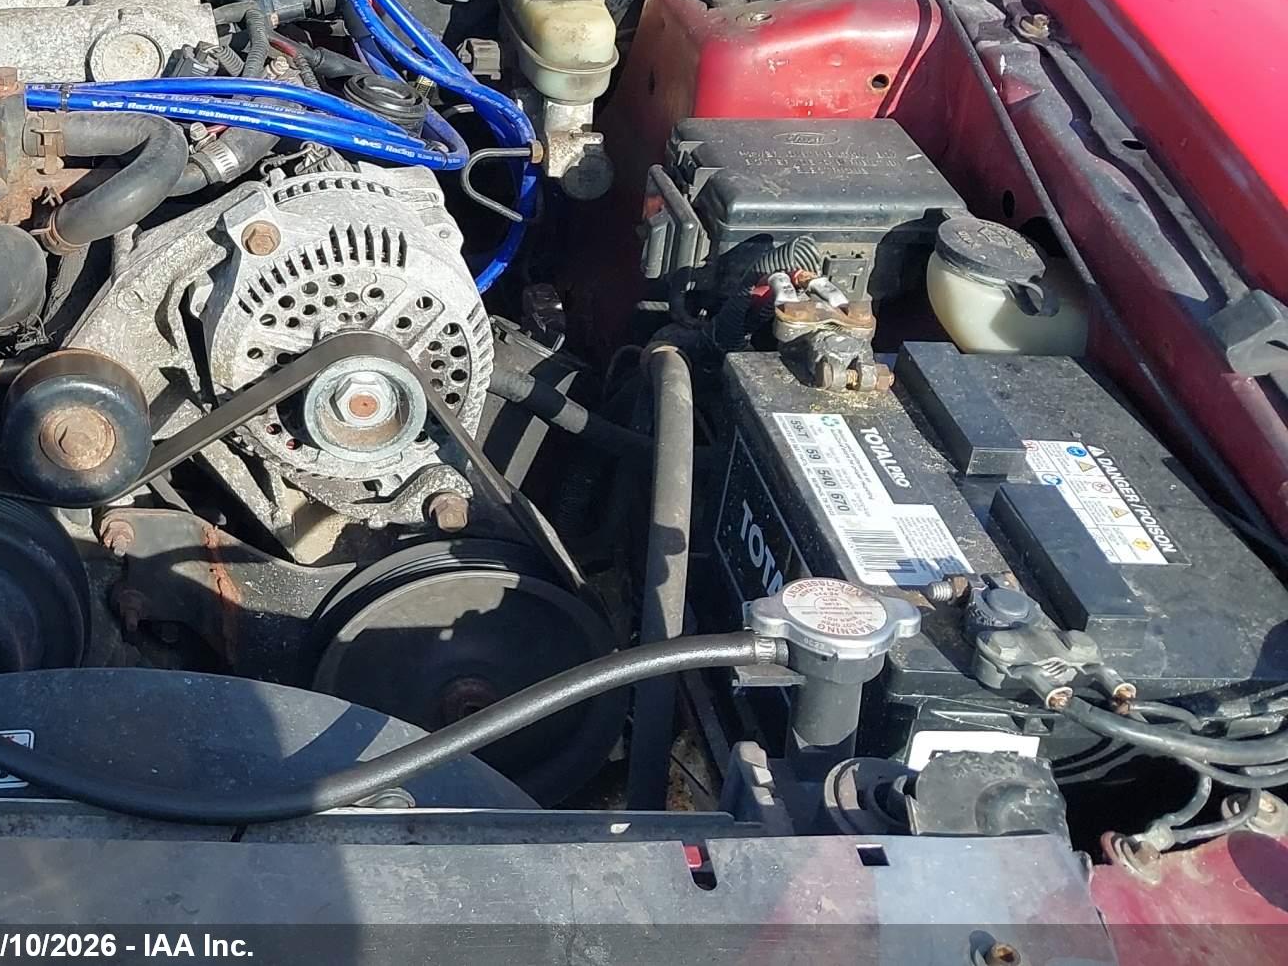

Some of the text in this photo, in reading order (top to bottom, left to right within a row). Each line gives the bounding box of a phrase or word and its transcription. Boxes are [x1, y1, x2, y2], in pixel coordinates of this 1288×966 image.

[171, 93, 210, 104] Racing
[91, 99, 124, 109] VMS
[127, 101, 167, 113] Racing
[352, 136, 382, 150] VMS
[385, 144, 415, 158] Racing
[860, 426, 912, 488] TOTALPRO
[790, 419, 810, 439] 59-T
[806, 449, 821, 461] 59
[817, 469, 836, 487] 540
[831, 493, 850, 512] 670
[817, 623, 877, 635] WARNING
[820, 620, 841, 628] OPEN
